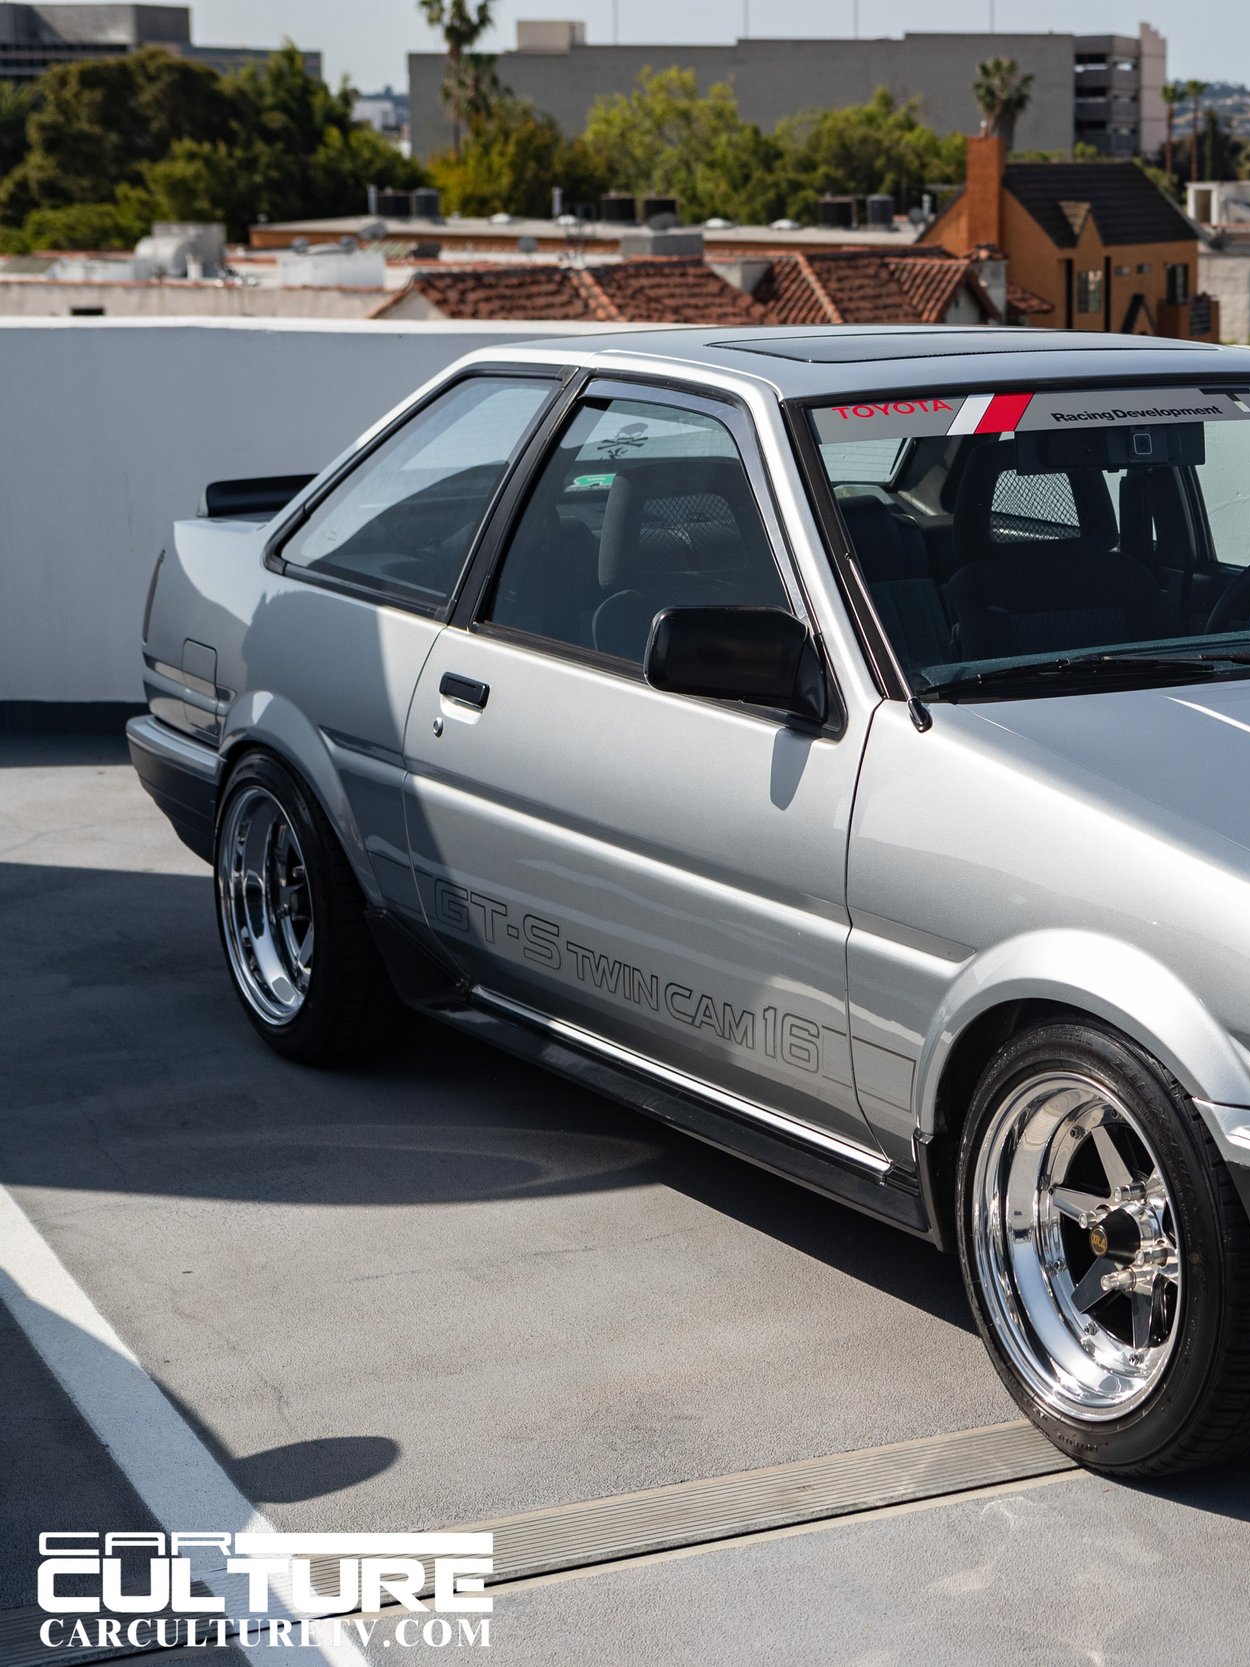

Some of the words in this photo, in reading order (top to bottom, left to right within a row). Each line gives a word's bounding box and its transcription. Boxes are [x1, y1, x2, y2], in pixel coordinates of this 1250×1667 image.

[831, 399, 953, 420] TOYOTA
[434, 878, 562, 971] GT-S
[567, 941, 659, 1013] TWIN
[666, 981, 755, 1051] CAM
[763, 1005, 820, 1075] 16
